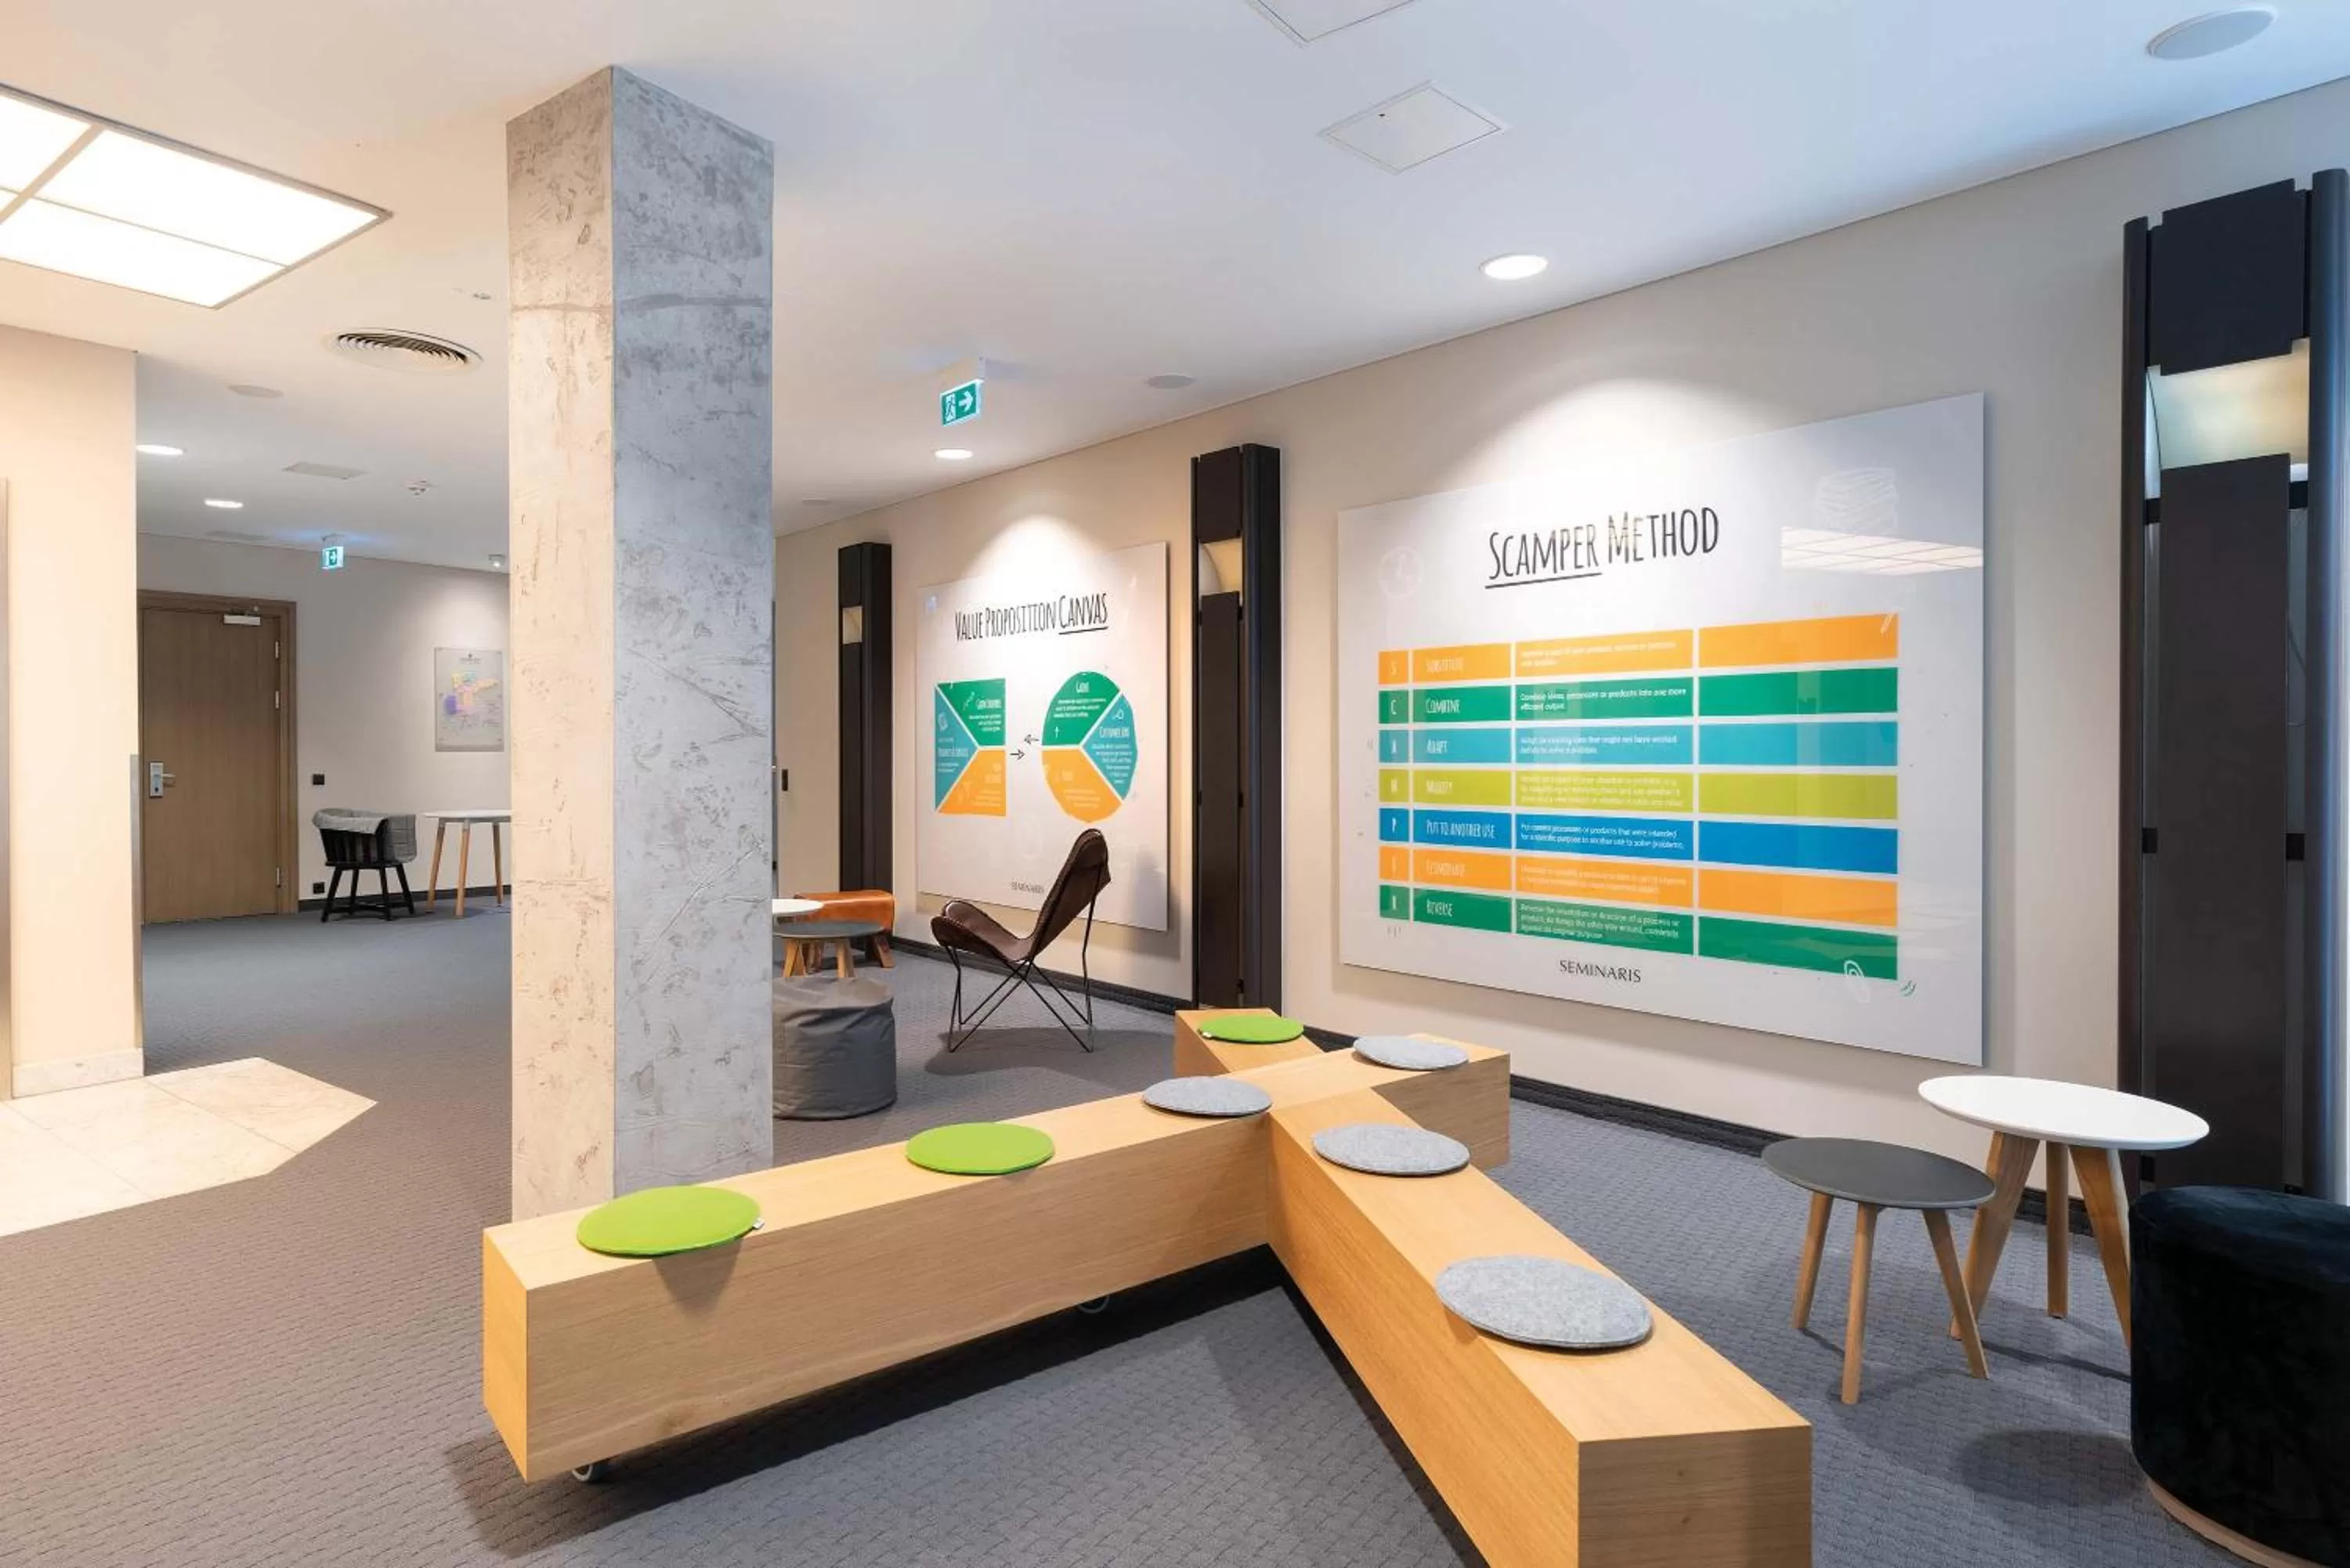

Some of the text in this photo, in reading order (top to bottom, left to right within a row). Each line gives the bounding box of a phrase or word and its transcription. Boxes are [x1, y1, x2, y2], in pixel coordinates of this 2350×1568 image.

[1488, 507, 1719, 580] SCAMPER METHOD
[955, 592, 1108, 642] VALUE PROPOSITION CANVAS
[1390, 699, 1397, 715] C
[1391, 817, 1397, 833] P
[1426, 819, 1439, 834] PUT
[1482, 823, 1496, 840] USE
[1560, 959, 1641, 983] SEMINARIS
